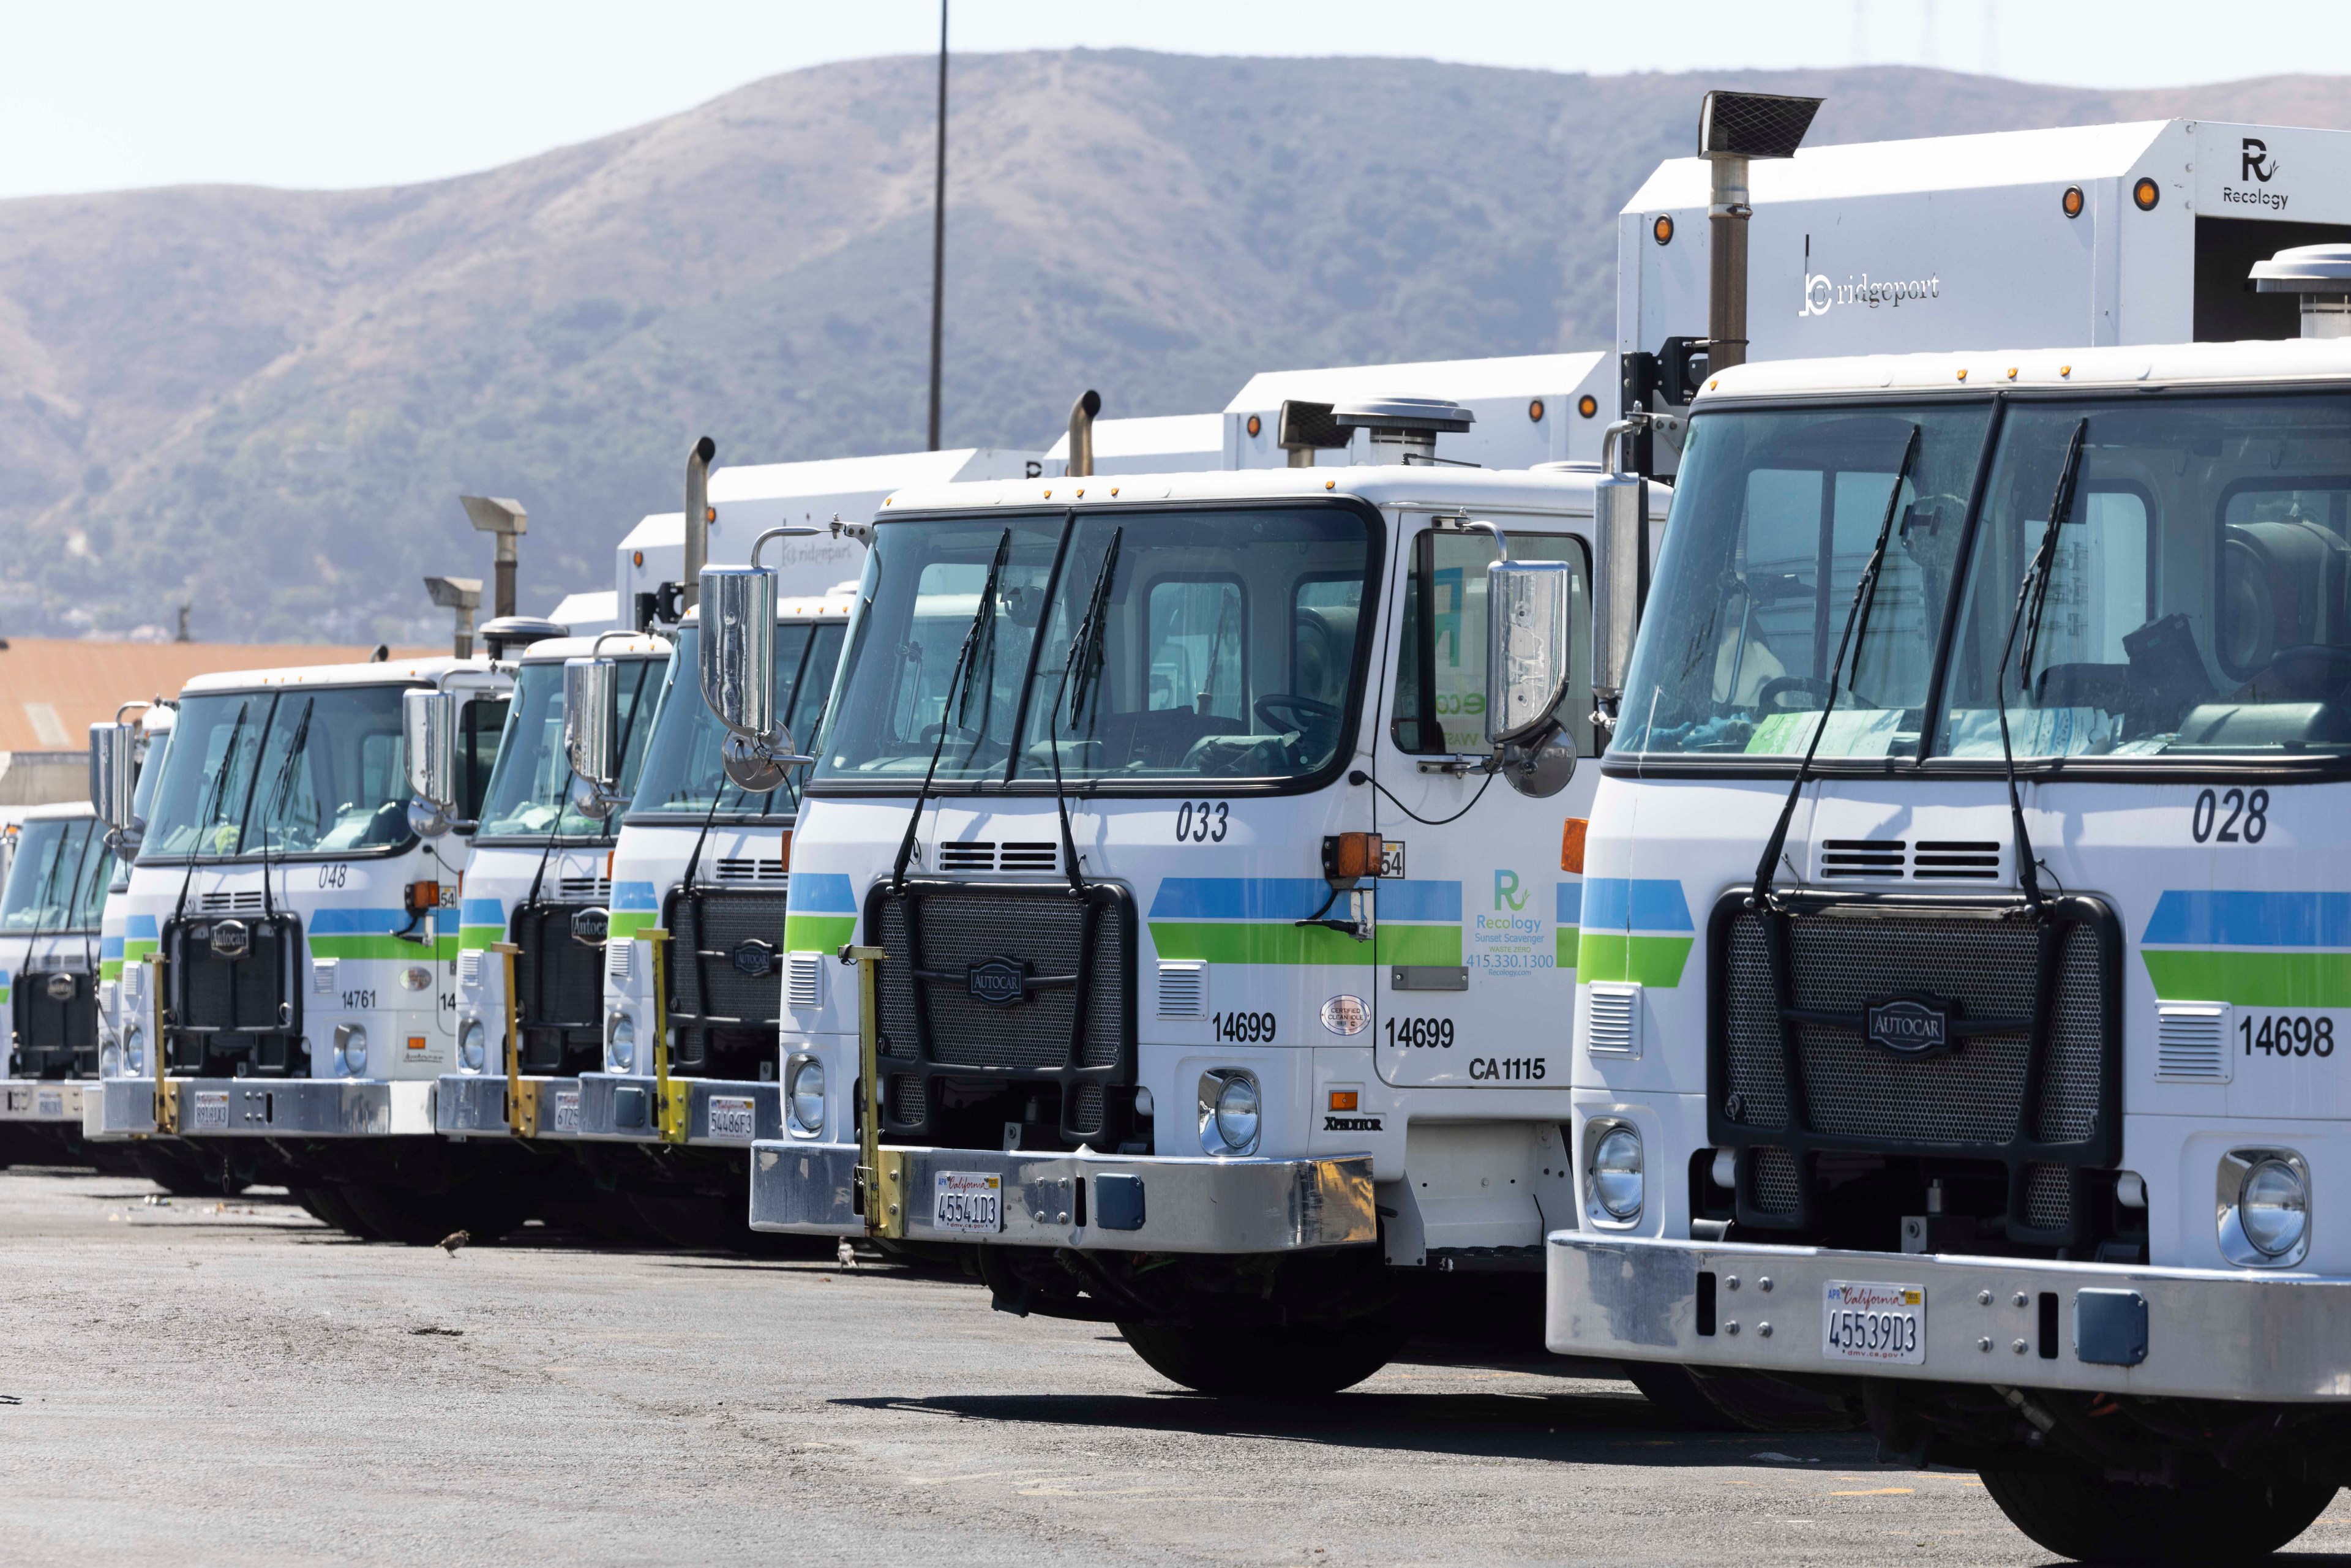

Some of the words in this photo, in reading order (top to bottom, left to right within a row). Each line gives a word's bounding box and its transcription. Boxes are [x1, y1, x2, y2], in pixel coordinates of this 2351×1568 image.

[2224, 187, 2289, 210] Recology
[1176, 801, 1229, 842] 033
[2192, 789, 2270, 844] 028
[319, 864, 347, 888] 048
[441, 893, 454, 906] 54
[1477, 914, 1542, 933] Recology
[1475, 933, 1502, 943] Sunset
[1504, 933, 1545, 944] Scavenger
[738, 953, 768, 965] AUTOCAR
[1466, 955, 1554, 968] 415.330.1300
[974, 974, 1018, 989] AUTOCAR
[342, 989, 376, 1010] 14761
[1212, 1011, 1276, 1043] 14699
[1385, 1017, 1454, 1048] 14699
[1874, 1014, 1940, 1037] AUTOCAR
[2240, 1015, 2334, 1057] 14698
[711, 1111, 751, 1133] 54486F3
[949, 1176, 989, 1193] California
[938, 1193, 996, 1223] 45541D3
[1828, 1289, 1840, 1300] APR
[1844, 1287, 1906, 1311] California
[1828, 1310, 1916, 1352] 45539D3
[1848, 1350, 1898, 1359] dmv.ca.gov
